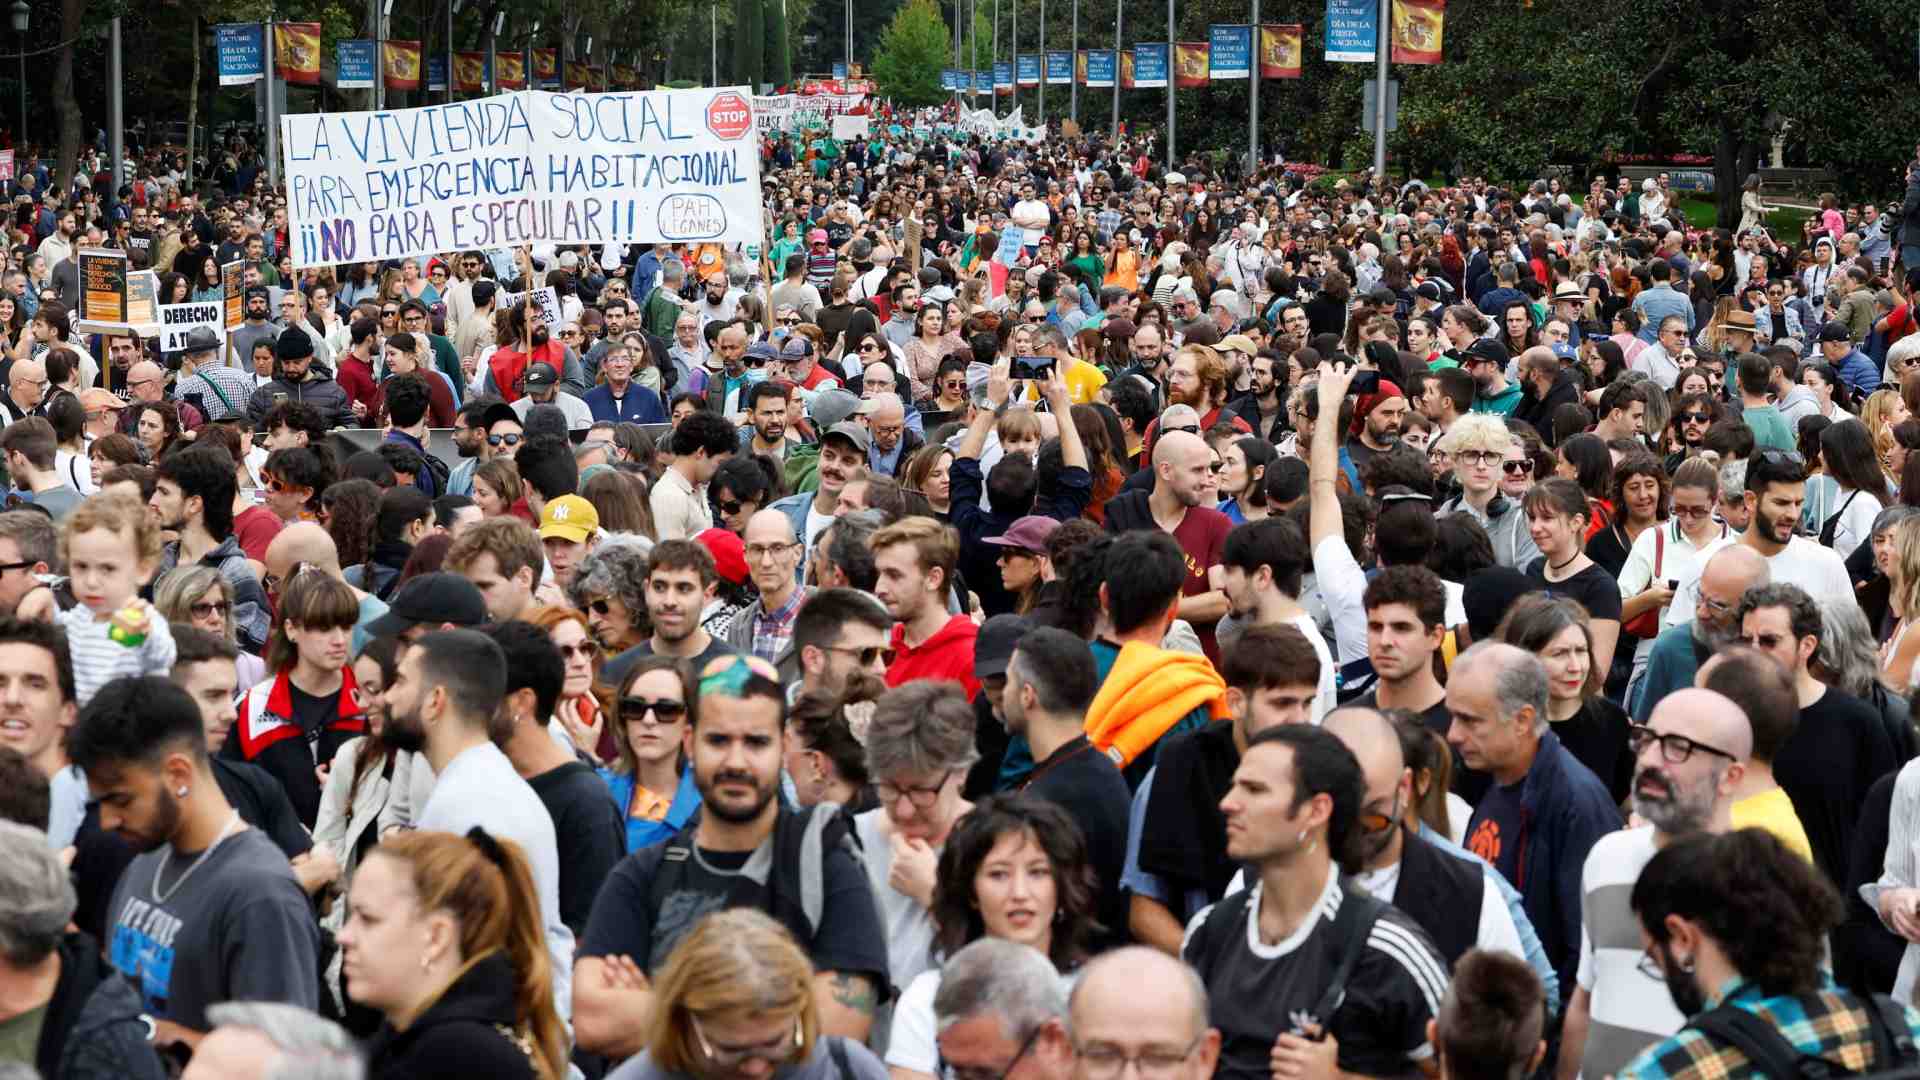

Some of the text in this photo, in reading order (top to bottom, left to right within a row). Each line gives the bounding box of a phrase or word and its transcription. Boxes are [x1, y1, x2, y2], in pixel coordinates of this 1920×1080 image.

[712, 110, 747, 124] STOP
[758, 115, 782, 129] CLASE
[289, 94, 693, 163] LA VIVIENDA SOCIAL
[293, 149, 747, 220] PARA EMERGENCIA HABITACIONAL
[671, 198, 711, 217] PAH
[369, 210, 439, 257] PARA
[164, 305, 218, 324] DERECHO
[169, 335, 177, 348] A
